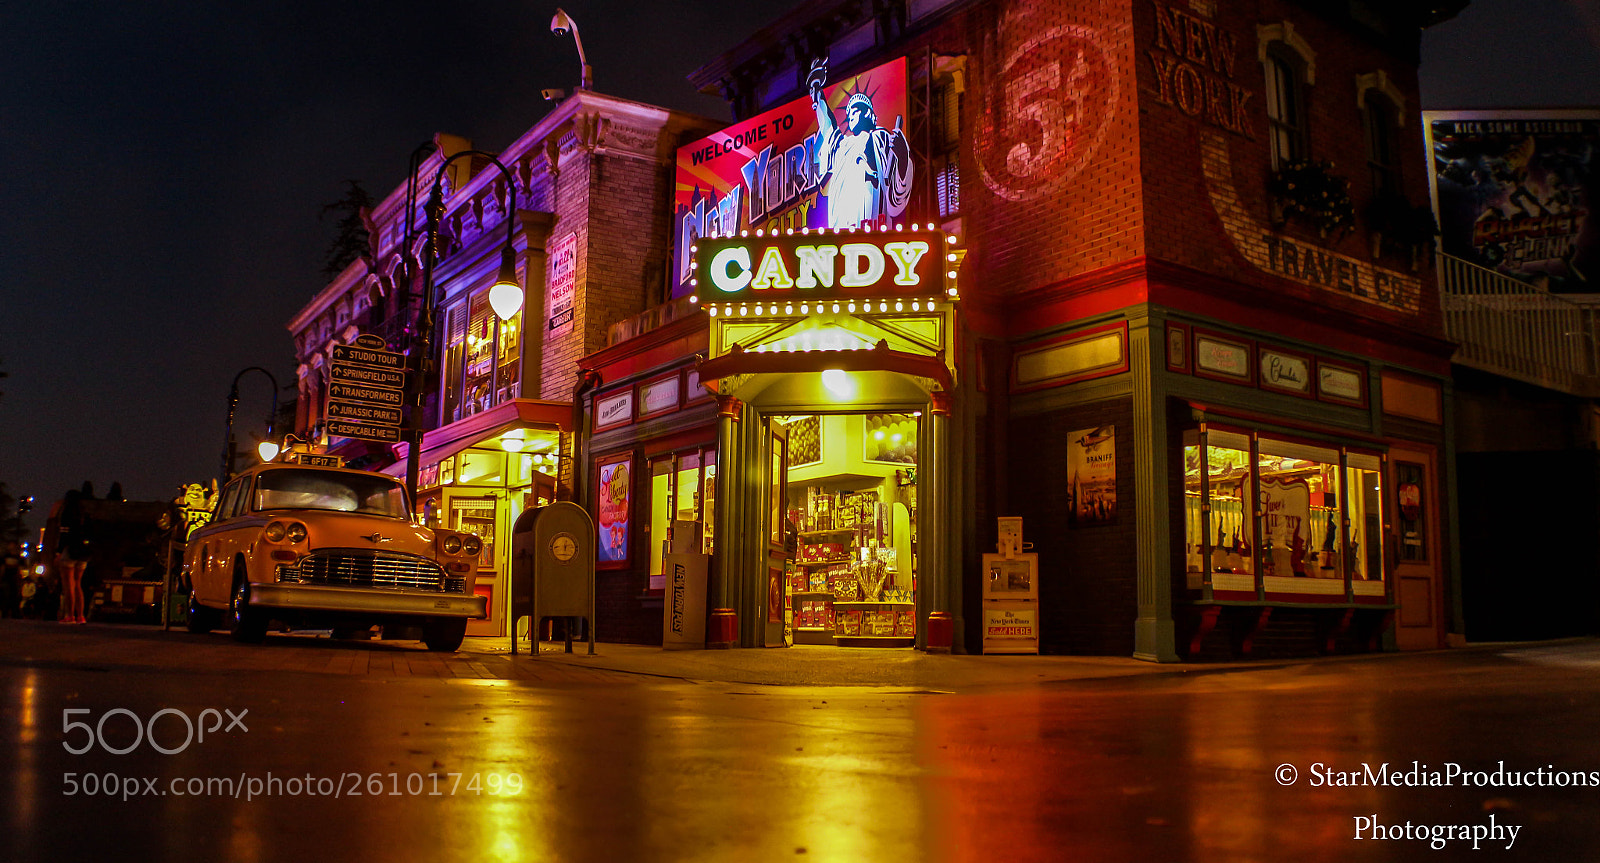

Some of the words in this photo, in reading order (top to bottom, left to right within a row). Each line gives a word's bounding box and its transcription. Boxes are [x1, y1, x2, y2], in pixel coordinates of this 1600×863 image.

[1154, 3, 1238, 78] NEW
[1149, 48, 1254, 140] YORK
[1454, 122, 1483, 133] KICK
[1488, 122, 1515, 133] SOME
[691, 124, 767, 167] WELCOME
[772, 113, 794, 137] TO
[740, 131, 832, 225] YORK
[766, 199, 812, 236] CITY
[710, 241, 929, 292] CANDY
[1262, 234, 1367, 297] TRAVEL
[551, 282, 574, 301] NELSON
[349, 350, 376, 362] STUDIO
[377, 354, 398, 365] TOUR
[342, 368, 387, 382] SPRINGFIELD
[341, 386, 399, 402] TRANSFORMERS
[339, 406, 373, 418] JURASSIC
[373, 411, 391, 420] PARK
[338, 424, 376, 437] DESPICABLE
[376, 428, 387, 438] ME
[1086, 453, 1112, 464] BRANIFF
[673, 584, 685, 613] YORK
[672, 611, 683, 637] POST
[1009, 627, 1031, 635] HERE
